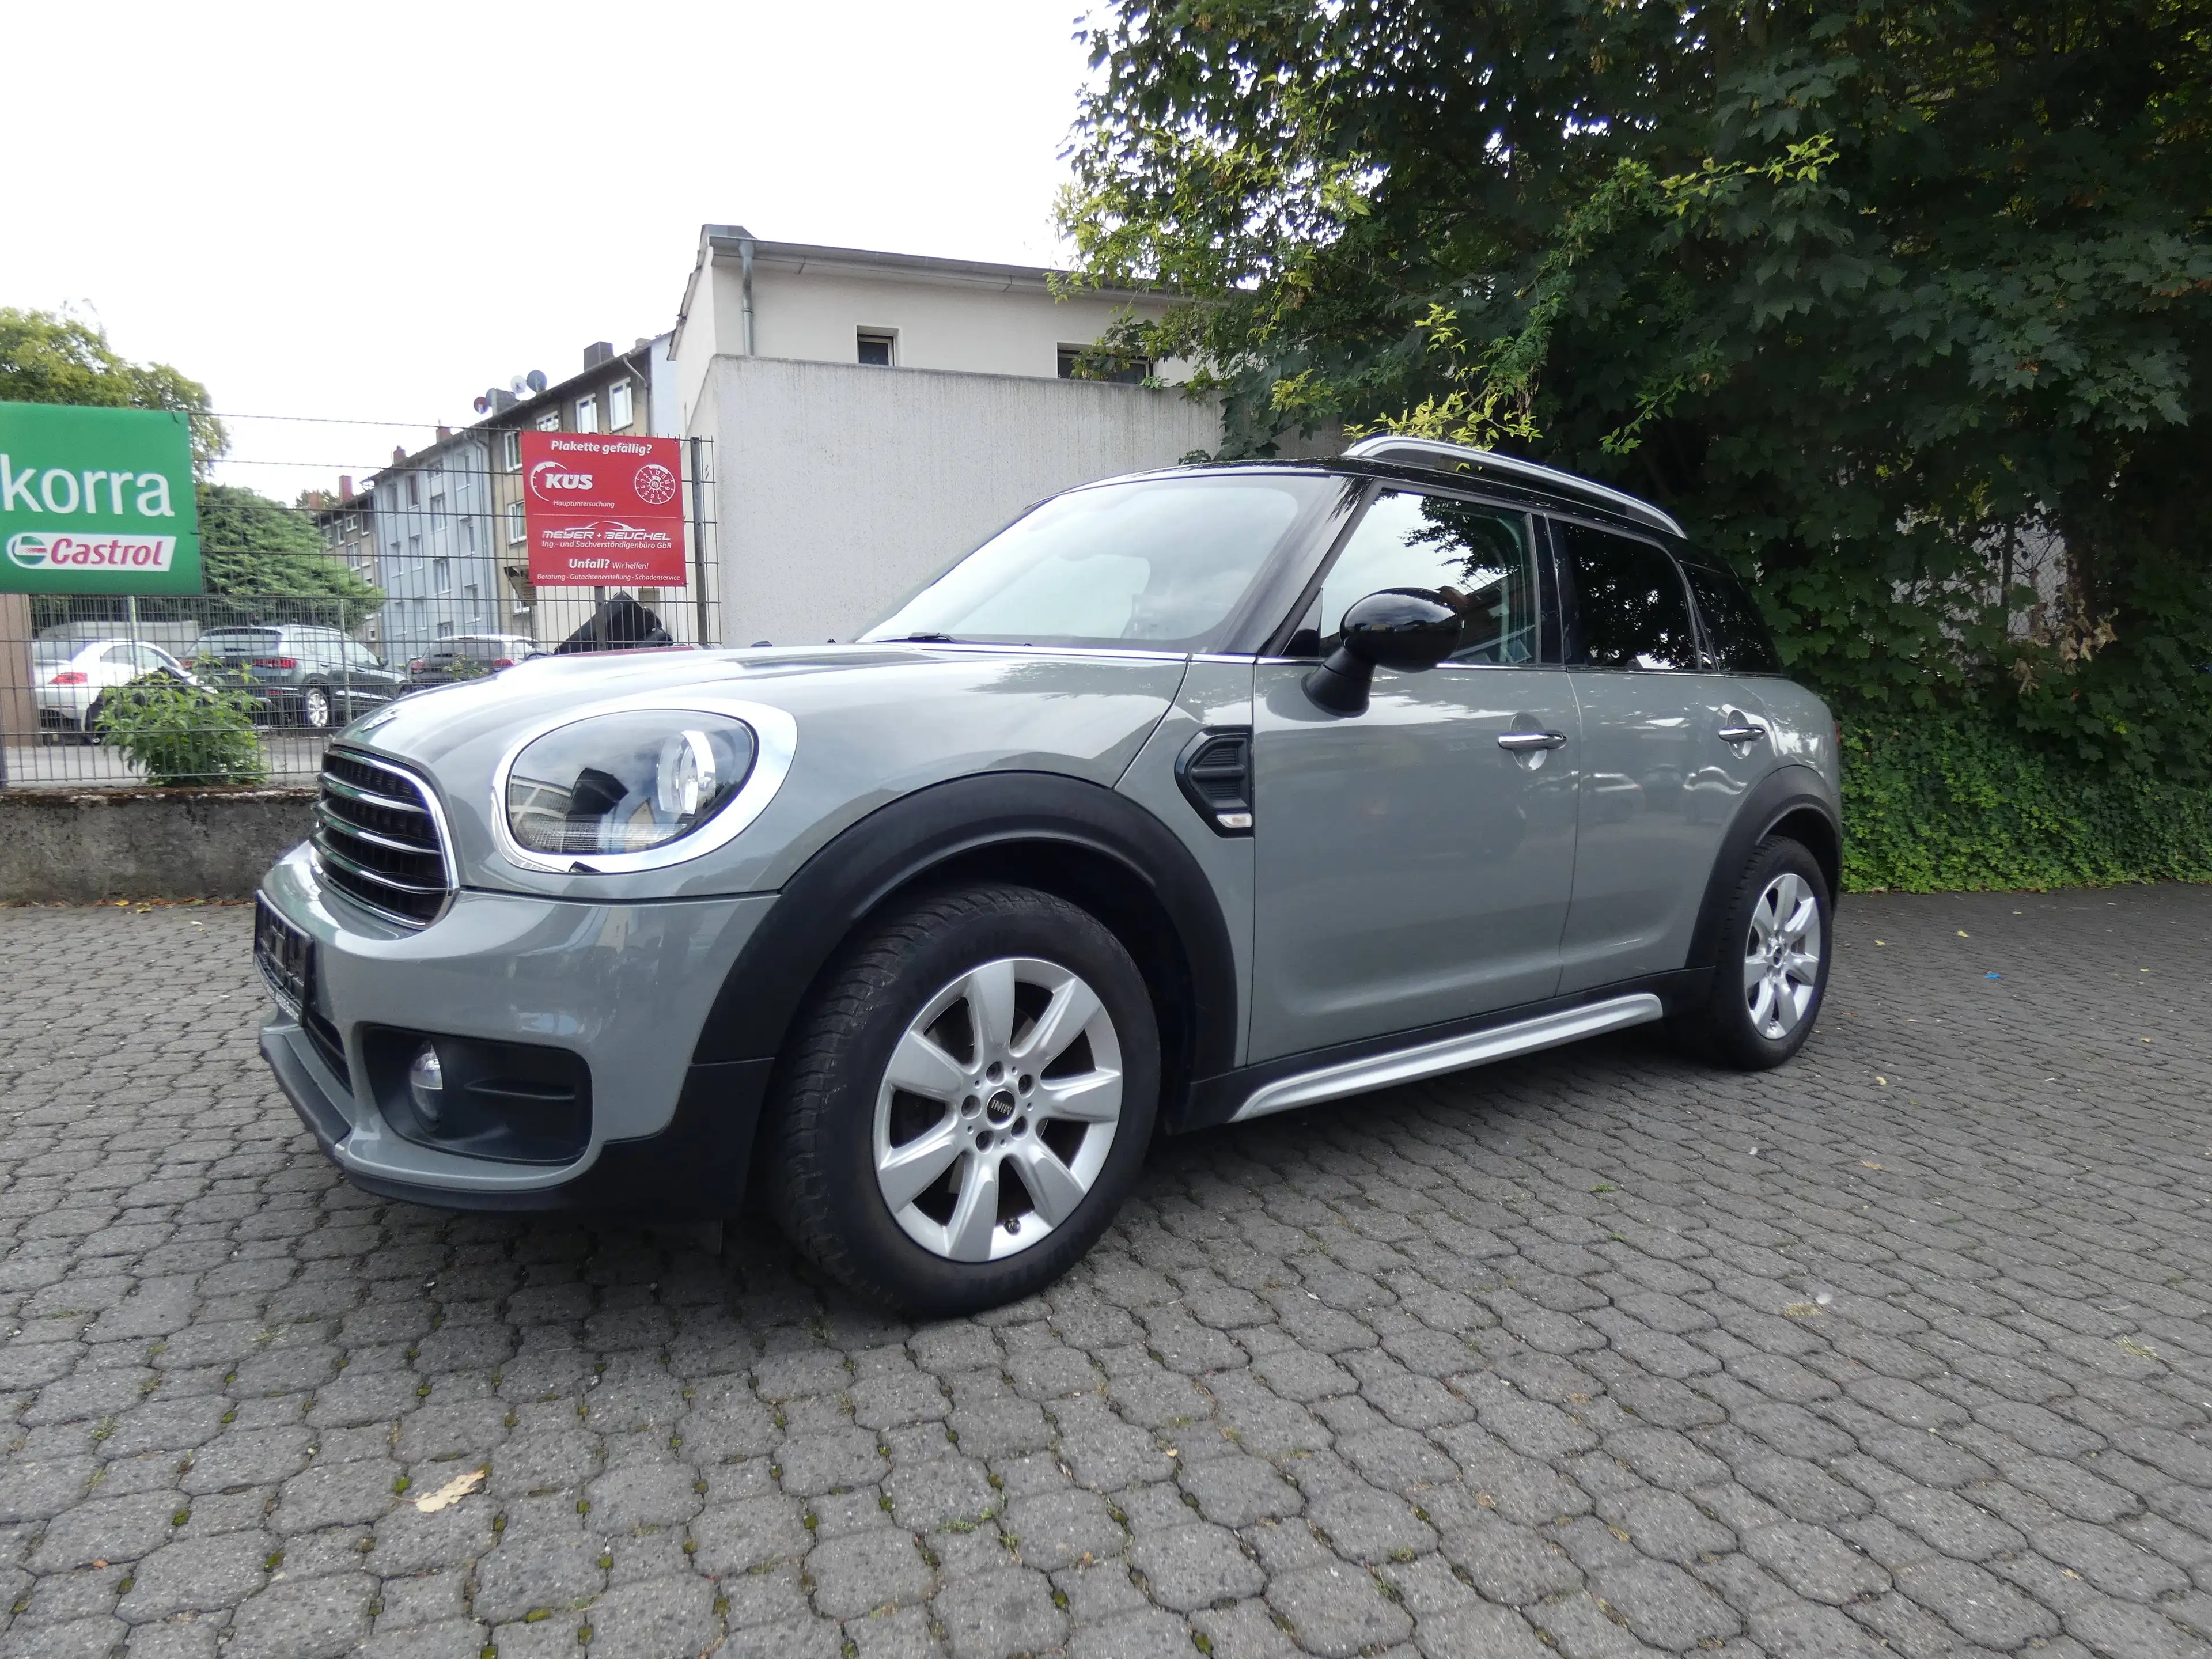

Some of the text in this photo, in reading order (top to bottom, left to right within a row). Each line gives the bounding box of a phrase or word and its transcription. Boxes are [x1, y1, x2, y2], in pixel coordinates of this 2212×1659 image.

[551, 440, 652, 456] Plakette gefällig?
[0, 453, 175, 517] korra
[545, 474, 593, 490] KÜS
[553, 500, 615, 509] Hauptuntersuchung
[541, 531, 594, 539] MEYER
[51, 538, 163, 566] Castrol
[541, 540, 558, 548] Ing.-
[575, 541, 656, 549] Sachverständigenbüro
[569, 558, 610, 569] Unfall?
[991, 1099, 1012, 1115] MINI
